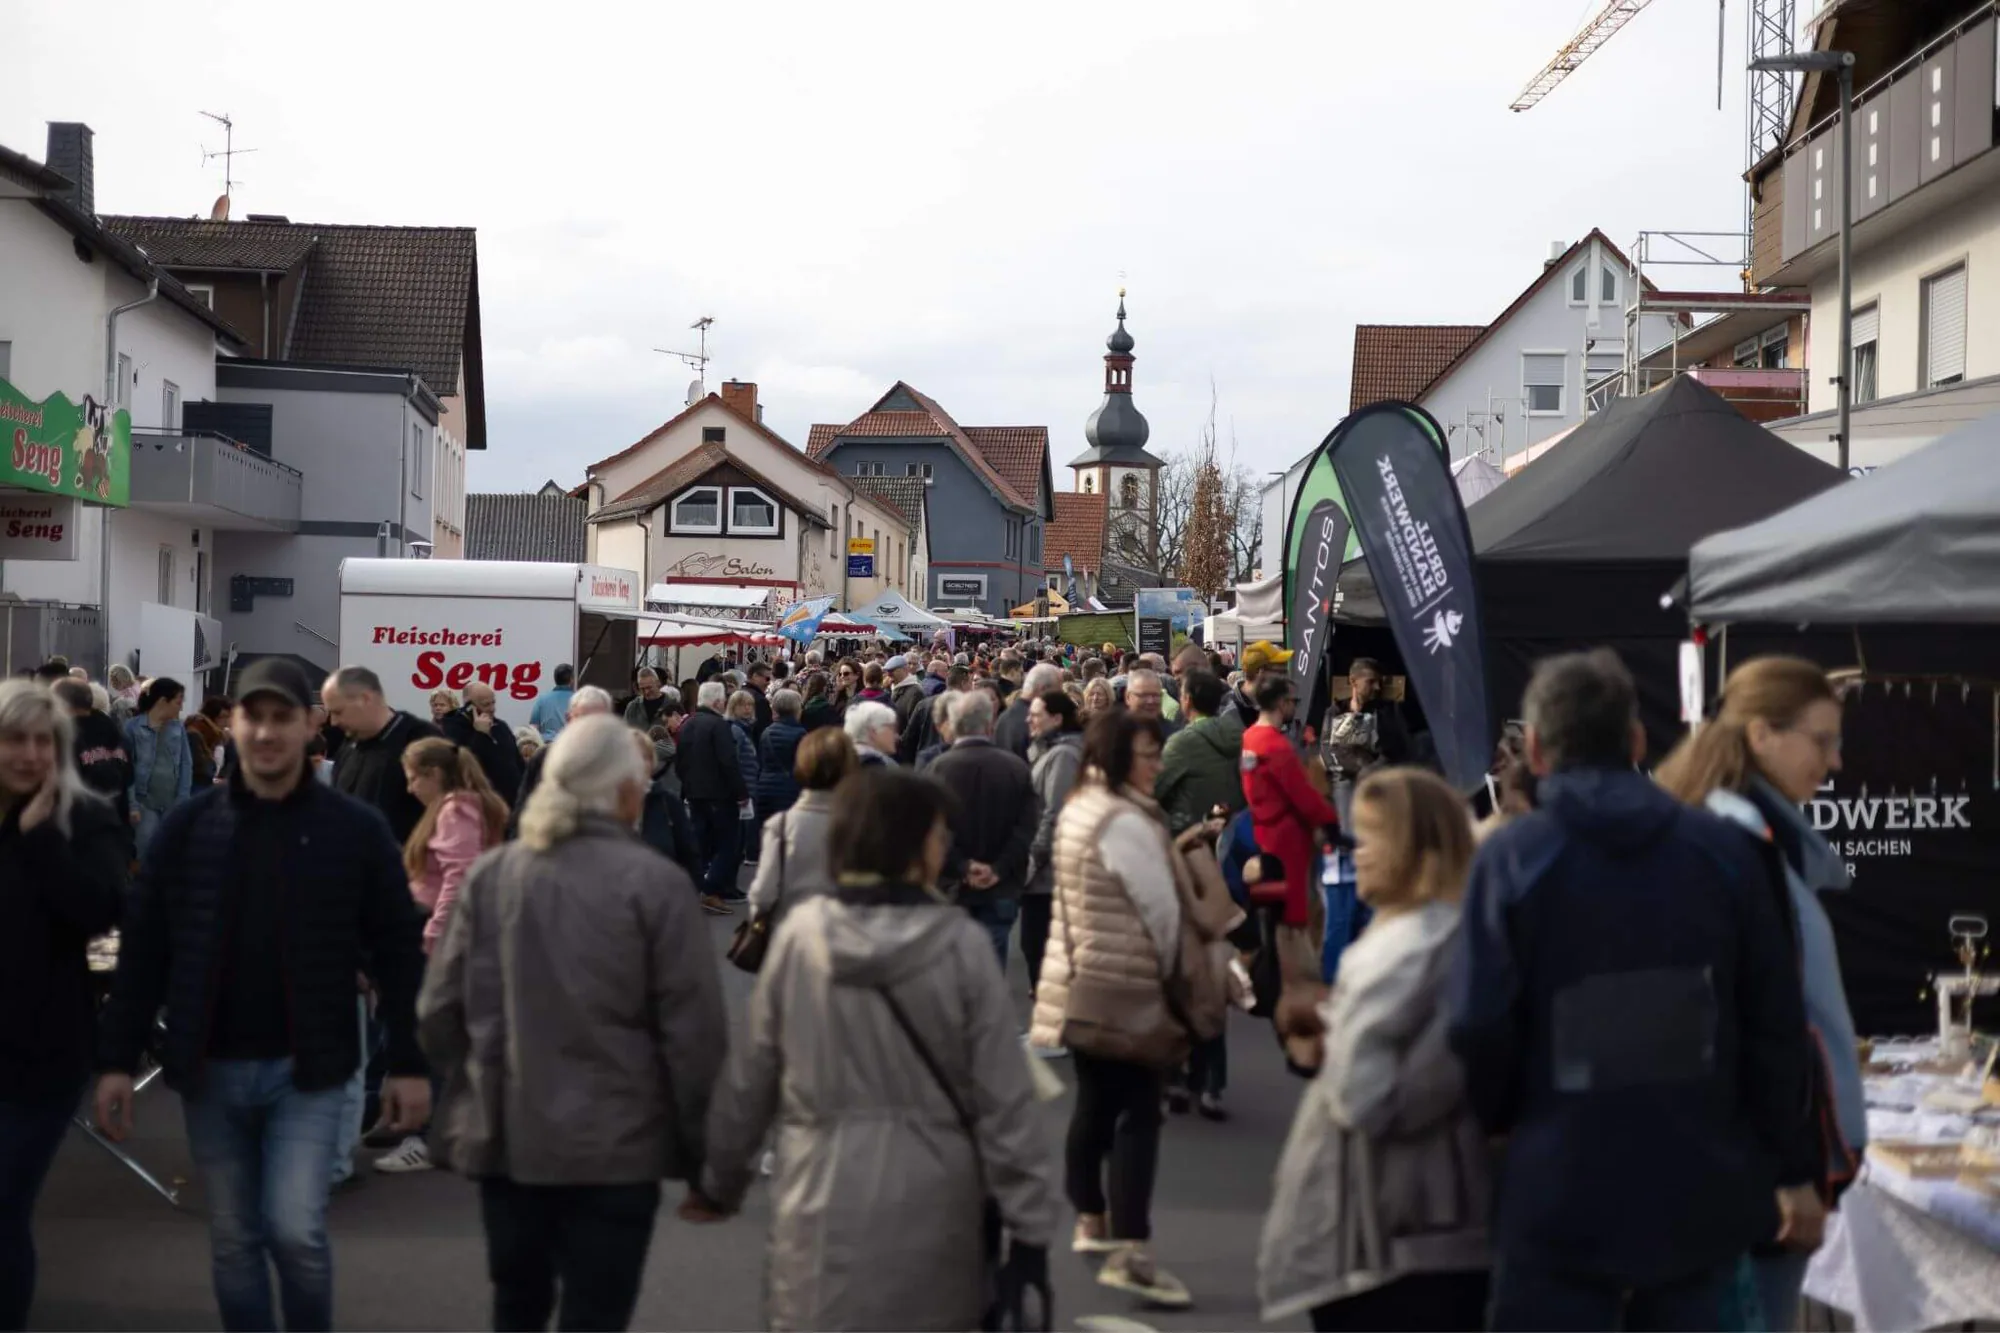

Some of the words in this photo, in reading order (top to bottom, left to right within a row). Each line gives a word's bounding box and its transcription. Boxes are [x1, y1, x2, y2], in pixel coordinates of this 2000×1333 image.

[12, 428, 62, 487] Seng
[6, 520, 63, 542] Seng
[723, 558, 775, 576] Salon
[1298, 516, 1334, 675] SANTOS
[372, 626, 503, 646] Fleischerei
[411, 650, 541, 700] Seng
[1803, 796, 1971, 830] DWERK
[1845, 840, 1912, 856] SACHEN
